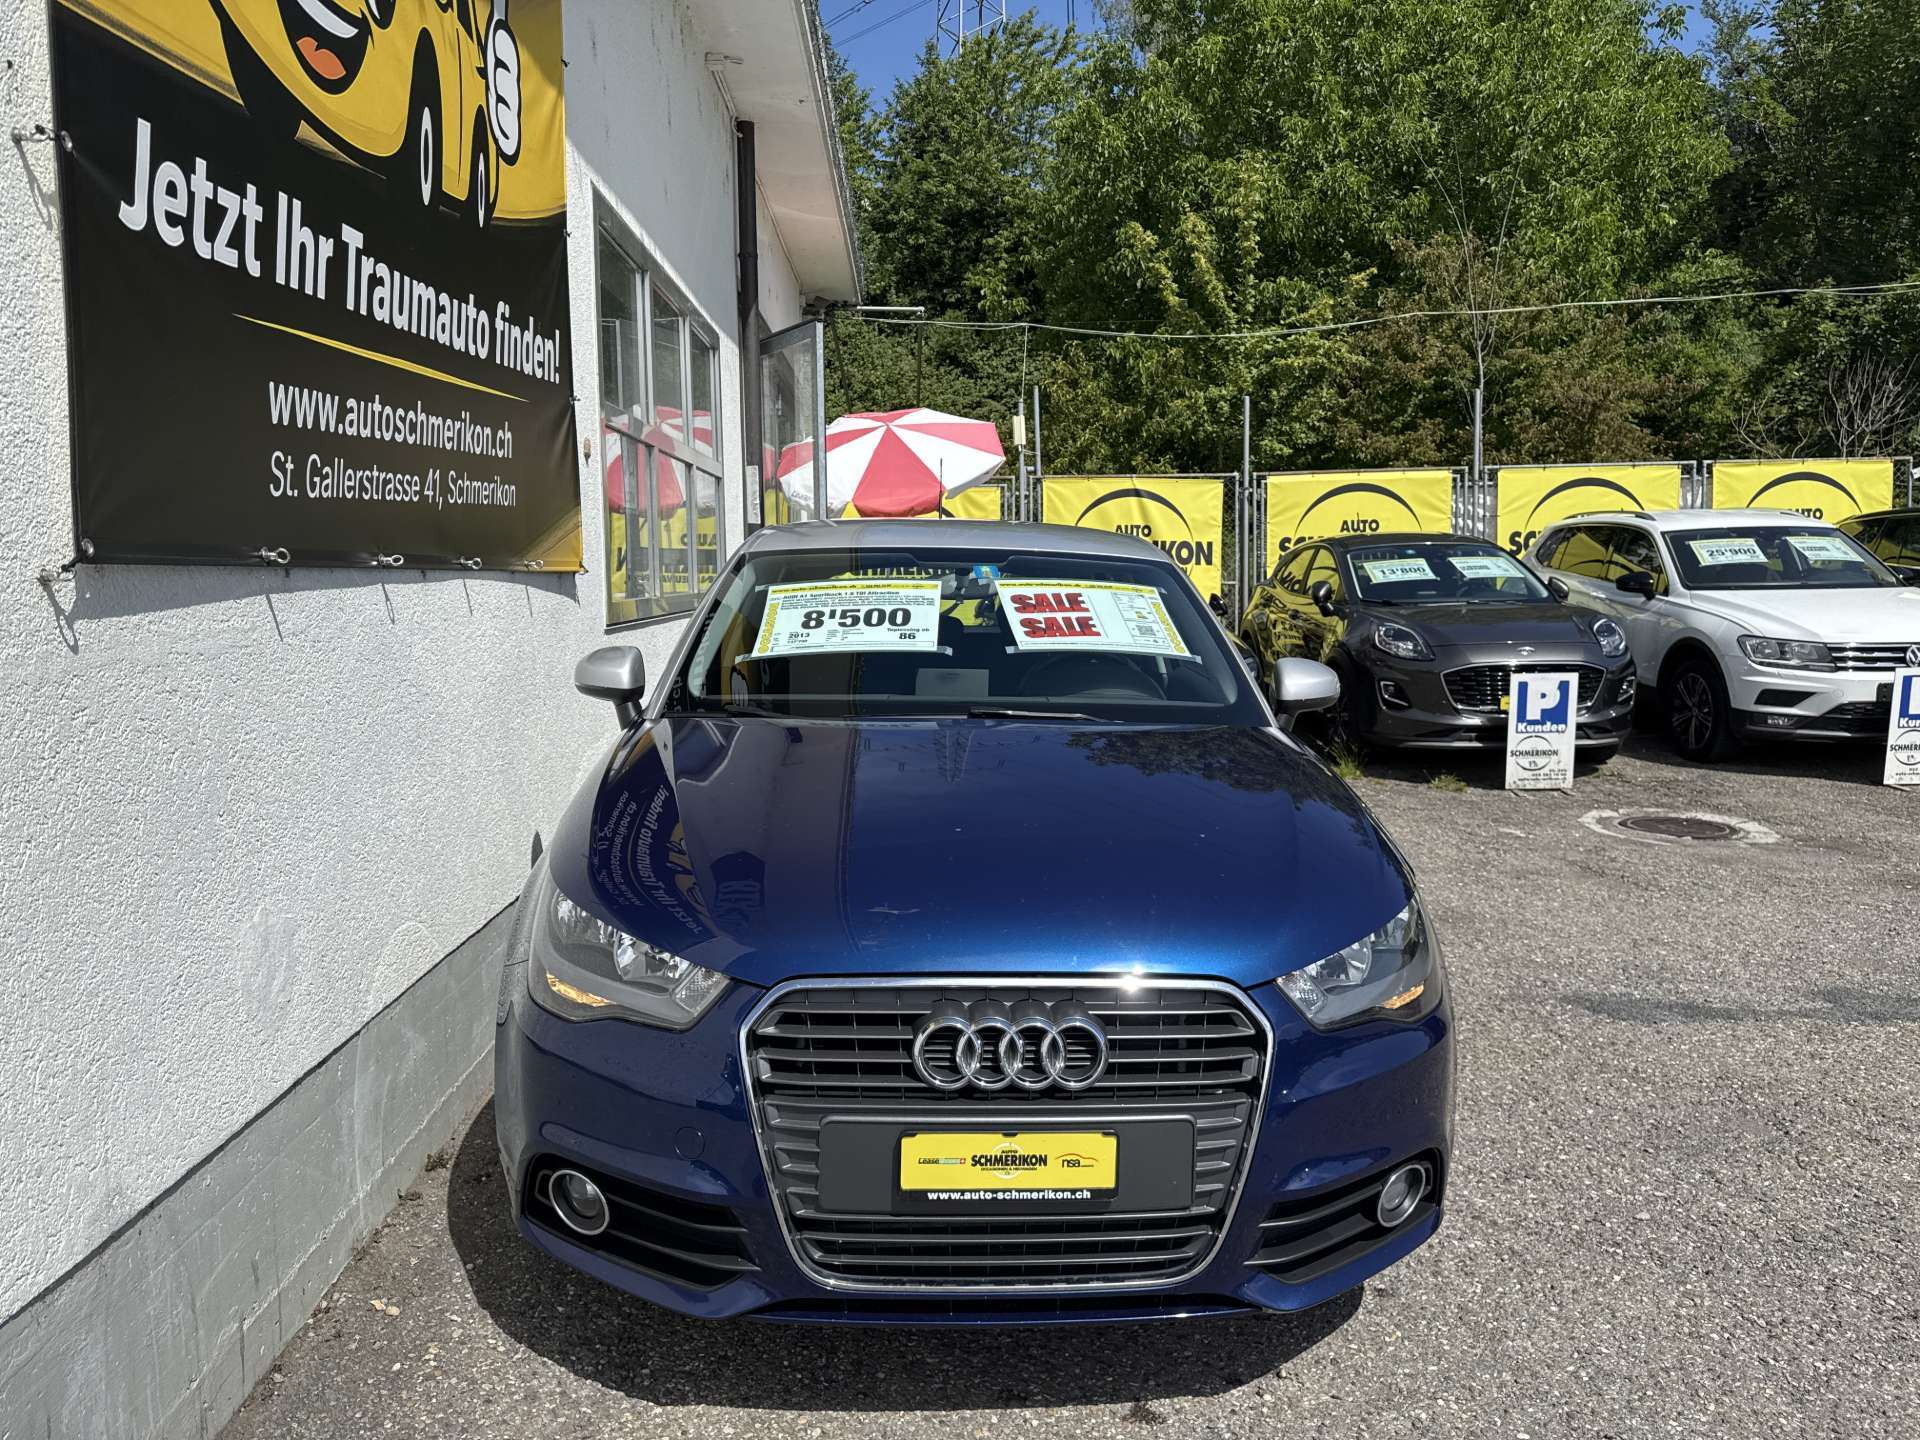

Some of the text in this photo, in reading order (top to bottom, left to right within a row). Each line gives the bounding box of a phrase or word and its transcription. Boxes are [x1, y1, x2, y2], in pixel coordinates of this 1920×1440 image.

[118, 117, 560, 385] Jetzt Ihr Traumauto finden!
[269, 381, 512, 458] www.autoschmerikon.ch
[269, 451, 516, 511] St. Gallerstrasse 41, Schmerikon
[1115, 524, 1152, 538] AUTO
[1339, 519, 1380, 533] AUTO
[1379, 566, 1427, 576] 13'800
[1010, 592, 1090, 614] SALE
[800, 607, 912, 630] 8'500
[1019, 616, 1102, 639] SALE
[899, 632, 917, 640] 86
[1518, 721, 1567, 733] Kunden
[1510, 749, 1558, 758] SCHMERIKON
[971, 1154, 1048, 1167] SCHMERIKON
[927, 1190, 1092, 1200] www.auto-schmerikon.ch
